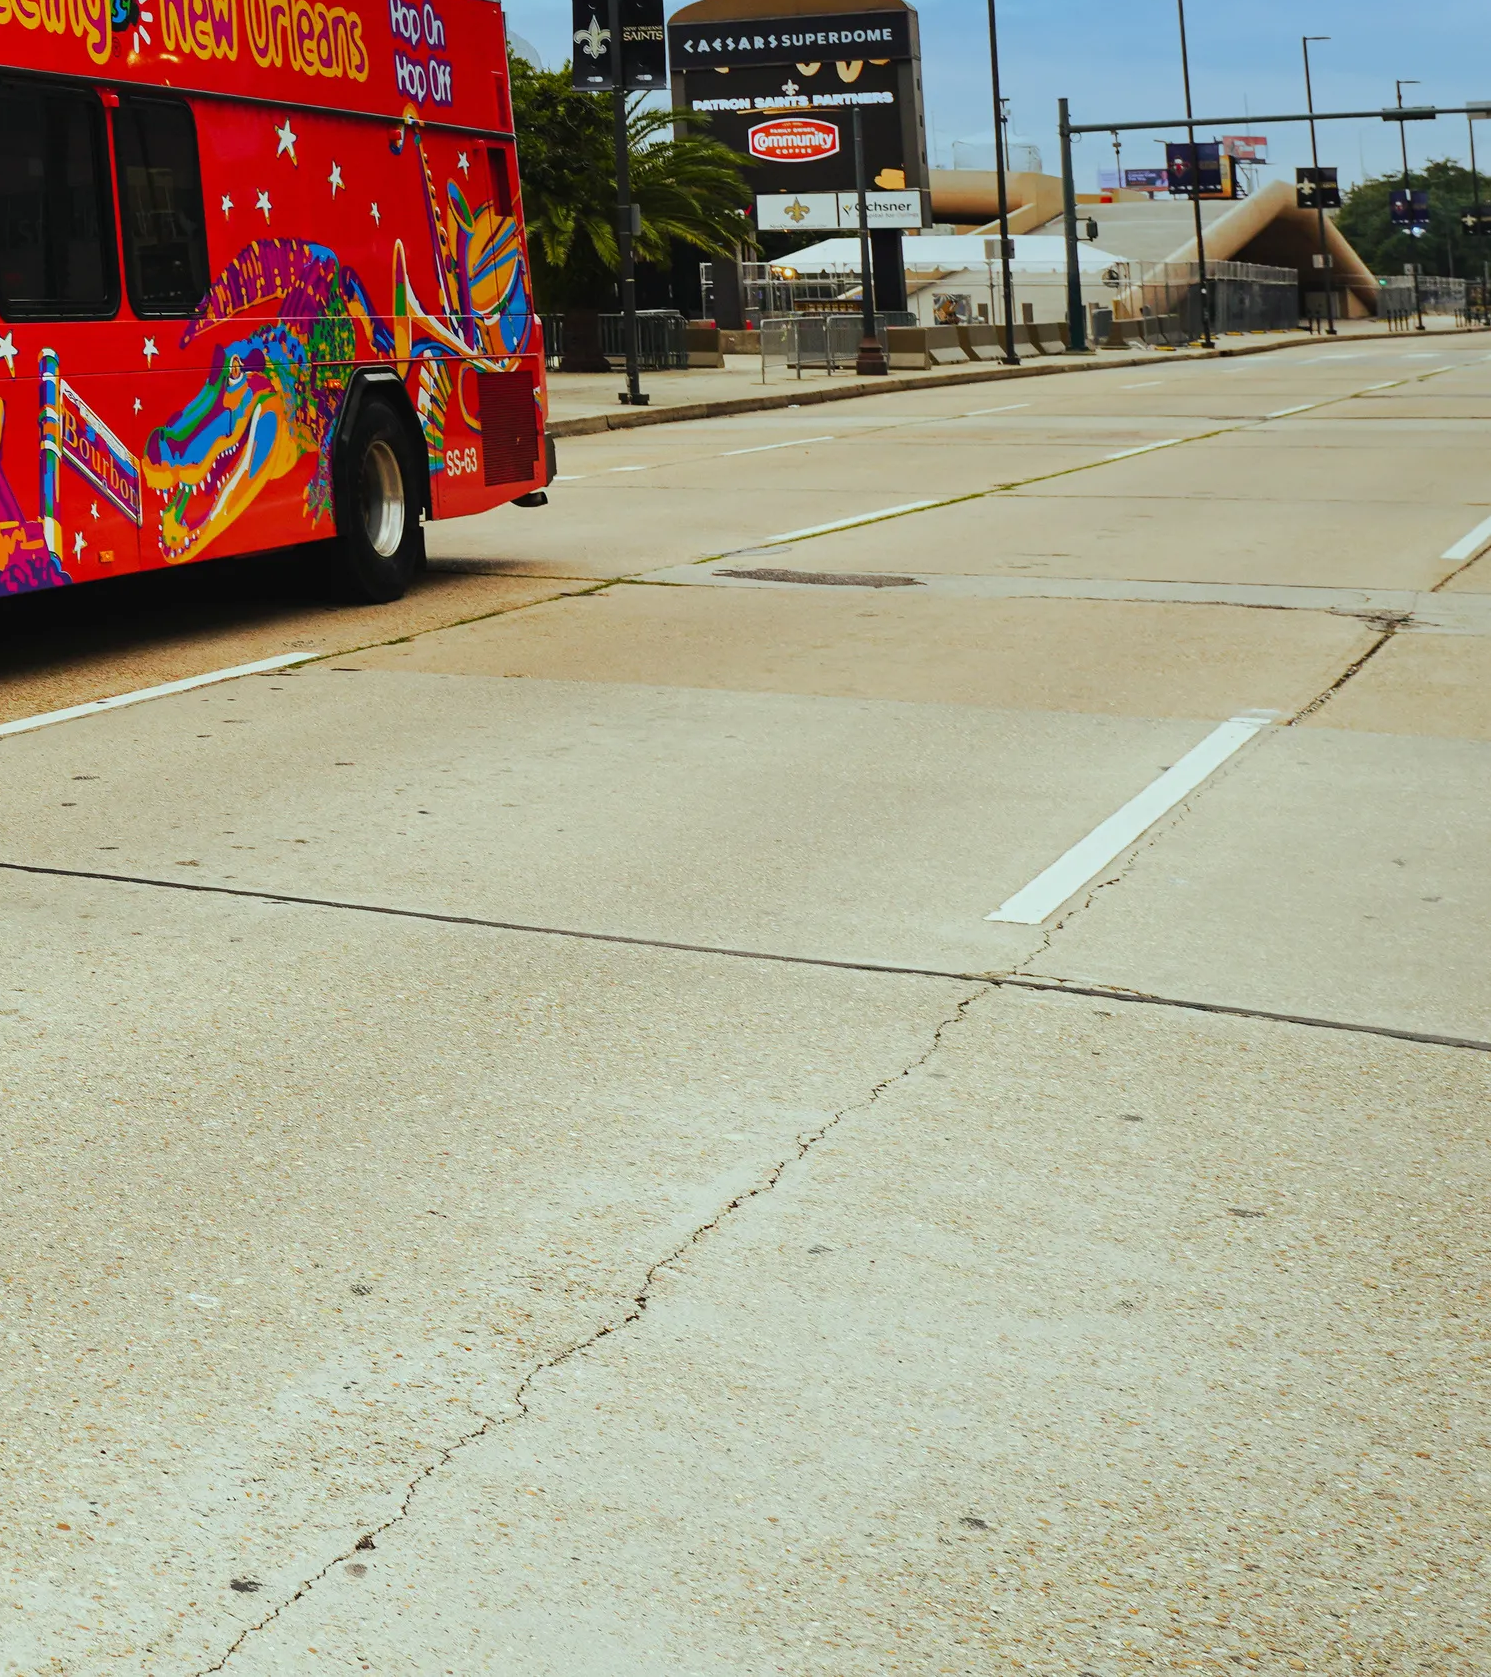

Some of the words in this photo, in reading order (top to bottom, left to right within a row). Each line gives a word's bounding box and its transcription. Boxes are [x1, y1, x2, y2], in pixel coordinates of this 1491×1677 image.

[423, 3, 445, 46] On
[623, 31, 664, 41] SAINTS
[683, 35, 778, 54] CAESARS
[781, 28, 893, 47] SUPERDOME
[395, 54, 427, 103] Hop
[429, 59, 452, 102] Off
[692, 97, 751, 112] PATRON
[754, 95, 810, 108] SAINTS
[812, 91, 894, 106] PARTNERS
[753, 132, 834, 152] Community
[64, 408, 140, 512] Bourbon
[446, 447, 477, 477] SS-63
